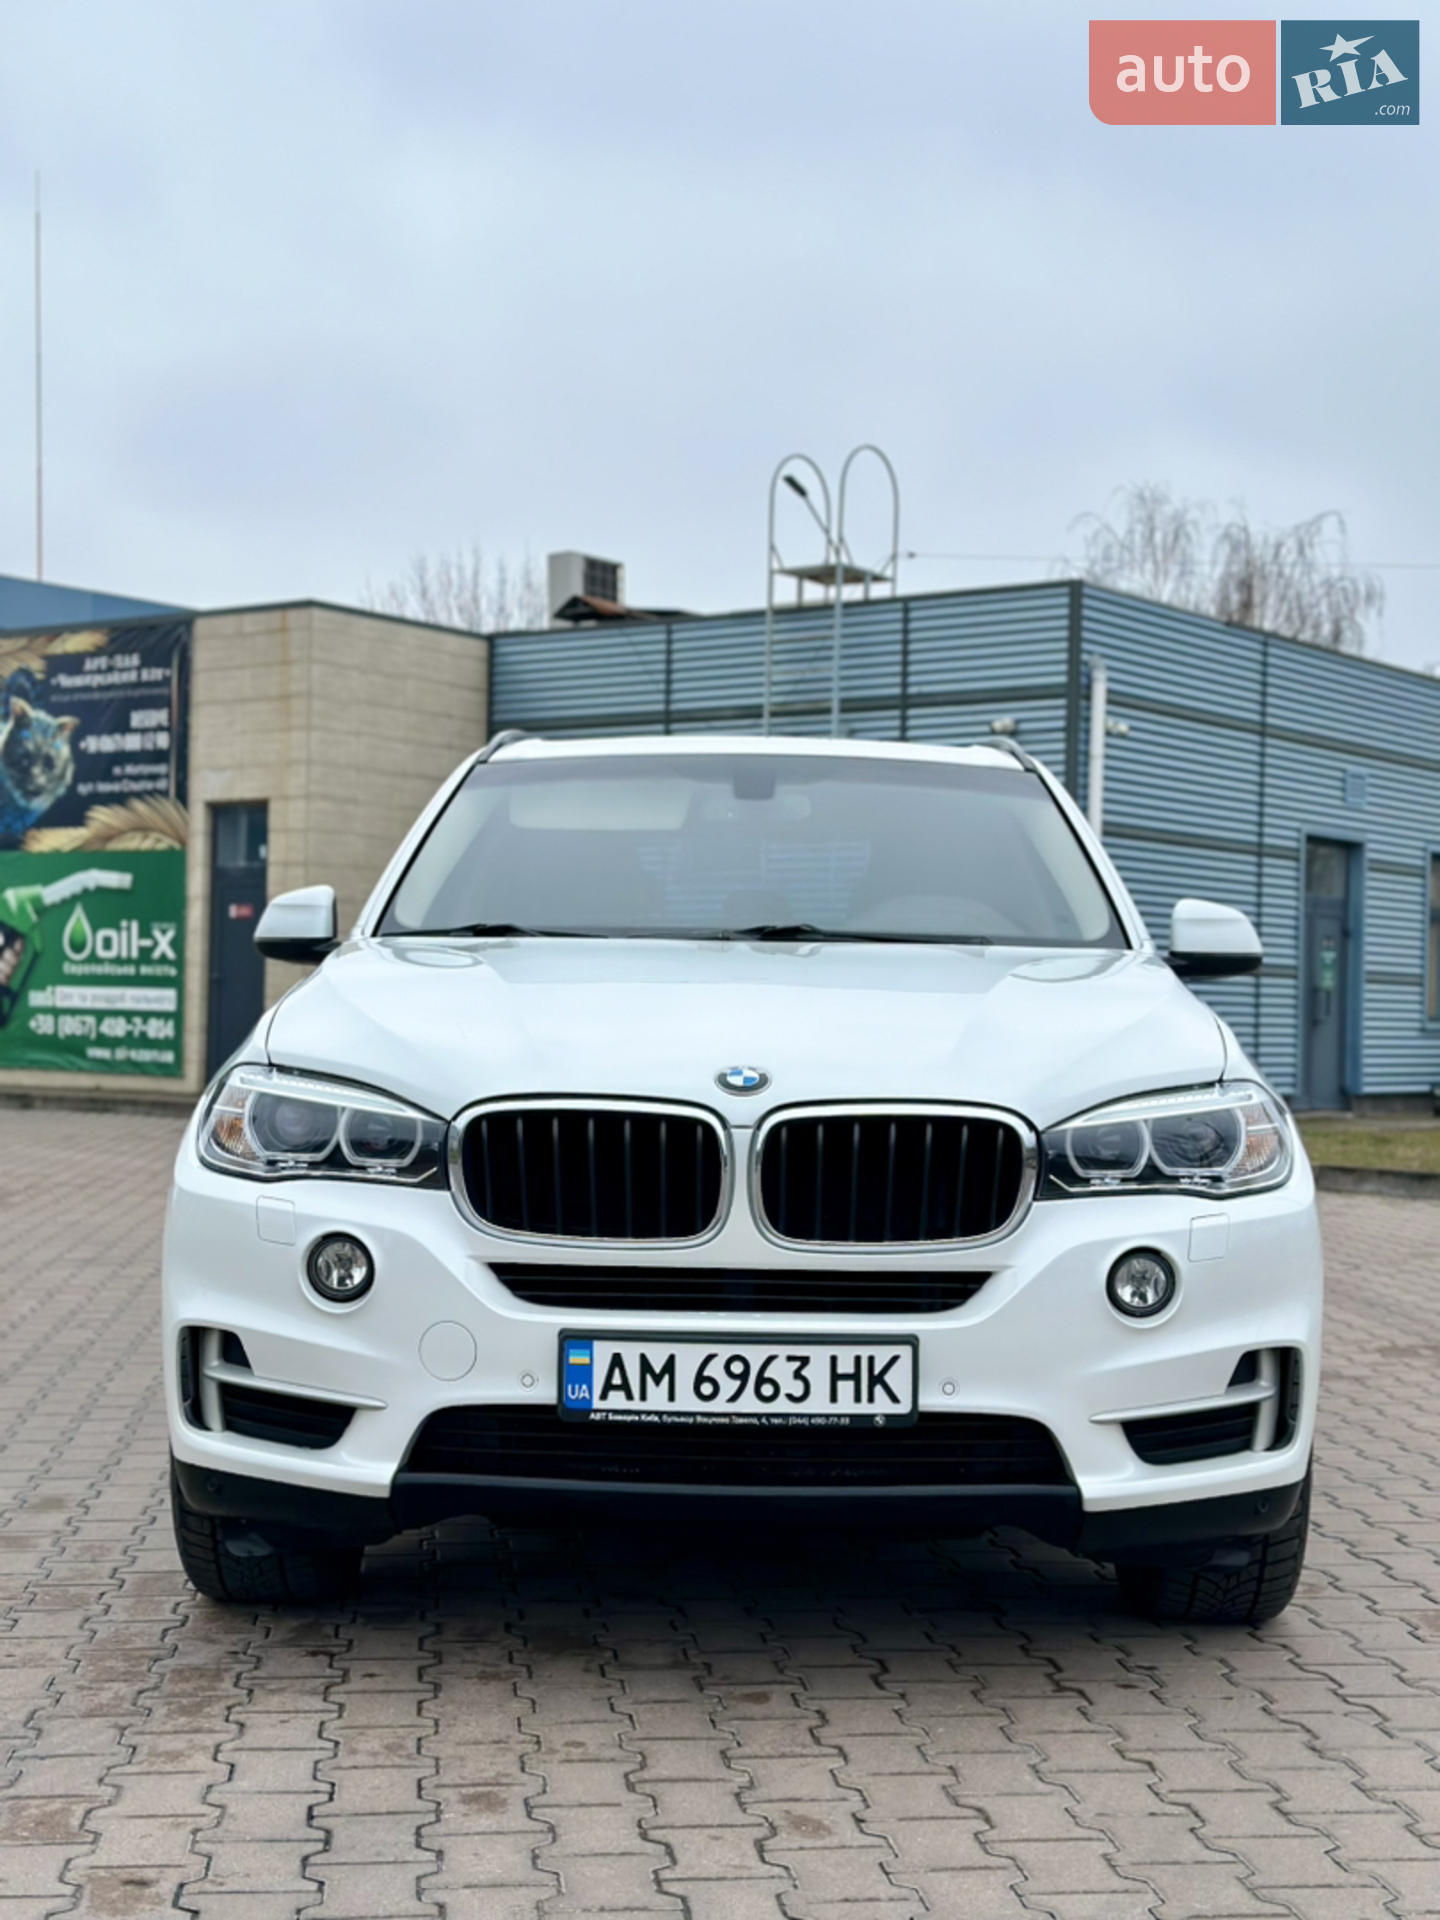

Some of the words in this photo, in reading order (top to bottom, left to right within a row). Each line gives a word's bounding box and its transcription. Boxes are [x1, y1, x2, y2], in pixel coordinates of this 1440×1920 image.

[95, 919, 177, 960] oil-x
[567, 1384, 590, 1400] UA
[599, 1352, 676, 1402] AM
[693, 1353, 811, 1404] 6963
[829, 1354, 902, 1405] HK
